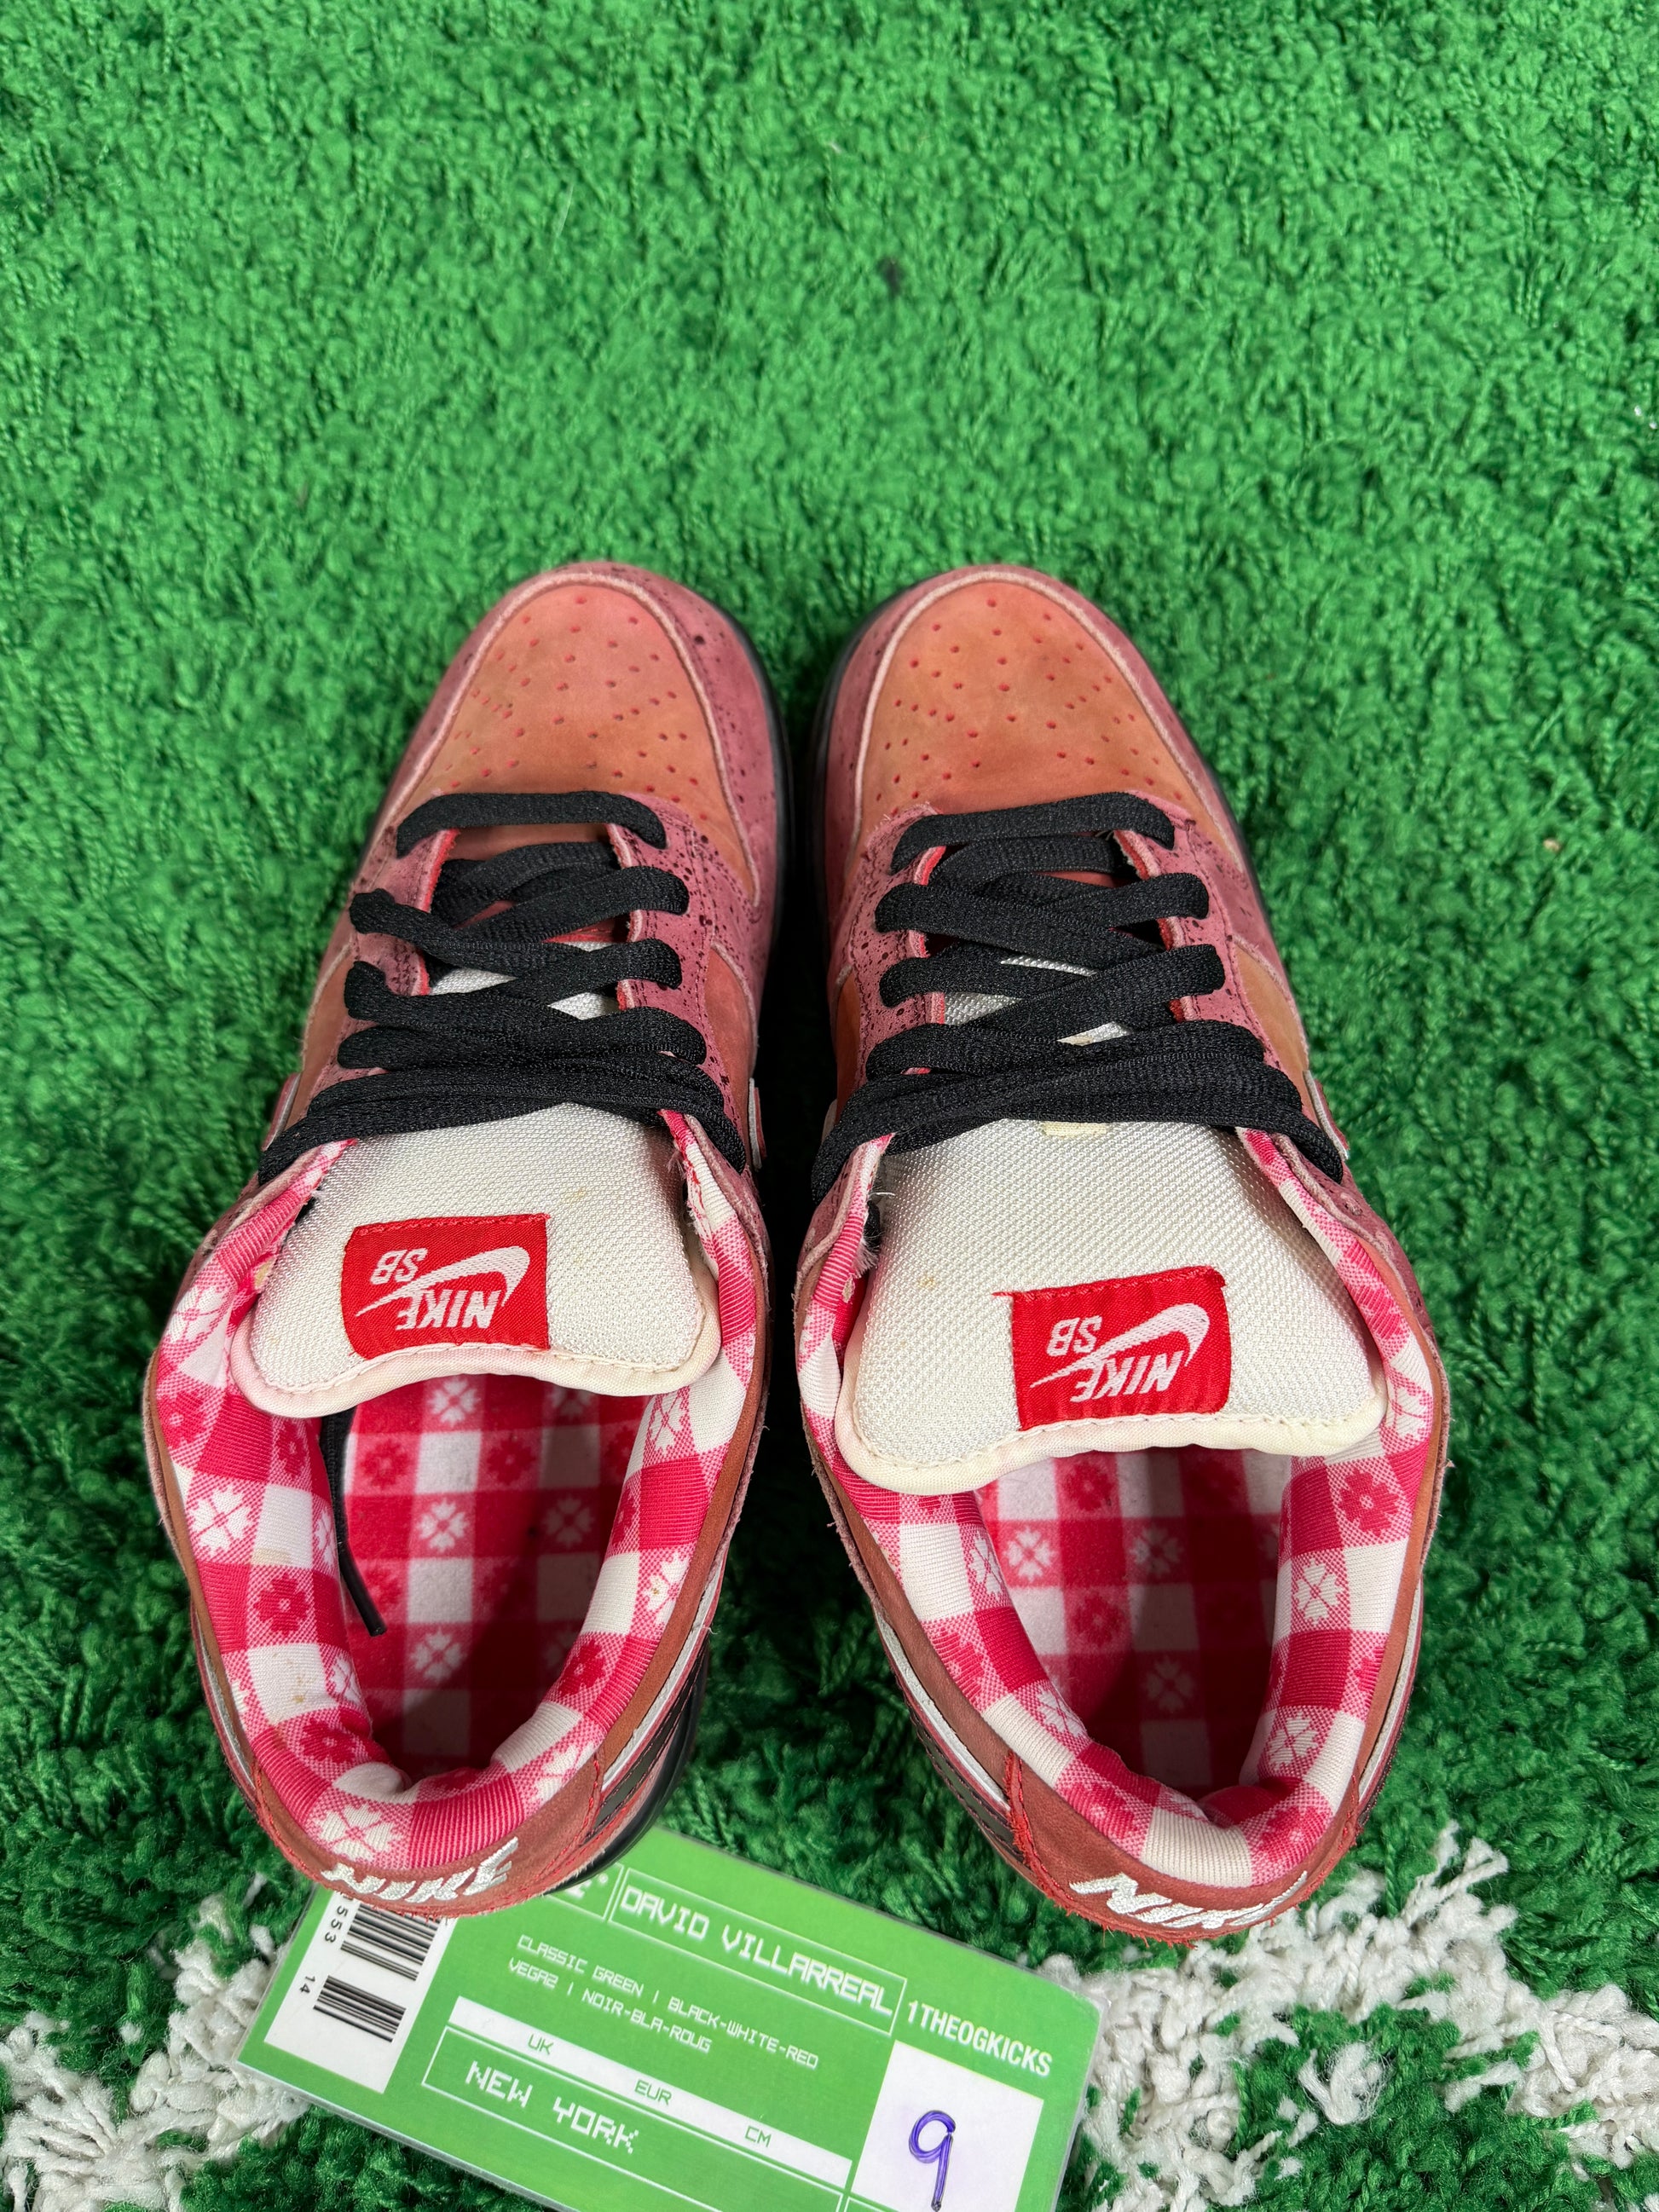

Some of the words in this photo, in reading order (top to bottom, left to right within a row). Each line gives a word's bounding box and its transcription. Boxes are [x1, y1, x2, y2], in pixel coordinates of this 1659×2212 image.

[369, 1247, 428, 1285] SB
[396, 1289, 501, 1331] NIKE
[1045, 1315, 1102, 1357] SB
[1070, 1350, 1184, 1403] NIKE
[299, 1975, 316, 1995] 14
[620, 1885, 709, 1940] DAVID
[721, 1924, 893, 2017] VILLARREAL
[517, 1933, 587, 1975] CLASSIC
[592, 1964, 644, 1998] GREEN
[668, 1995, 818, 2071] BLACK-WHITE-RED
[581, 1988, 713, 2054] NOIR-BLA-ROUG
[907, 2000, 1053, 2077] 1THEOGKICKS
[465, 2059, 534, 2108] NEW
[552, 2095, 639, 2155] YORK
[528, 2033, 554, 2056] UK
[634, 2078, 673, 2106] EUR
[744, 2124, 772, 2148] CM
[908, 2109, 957, 2211] 9
